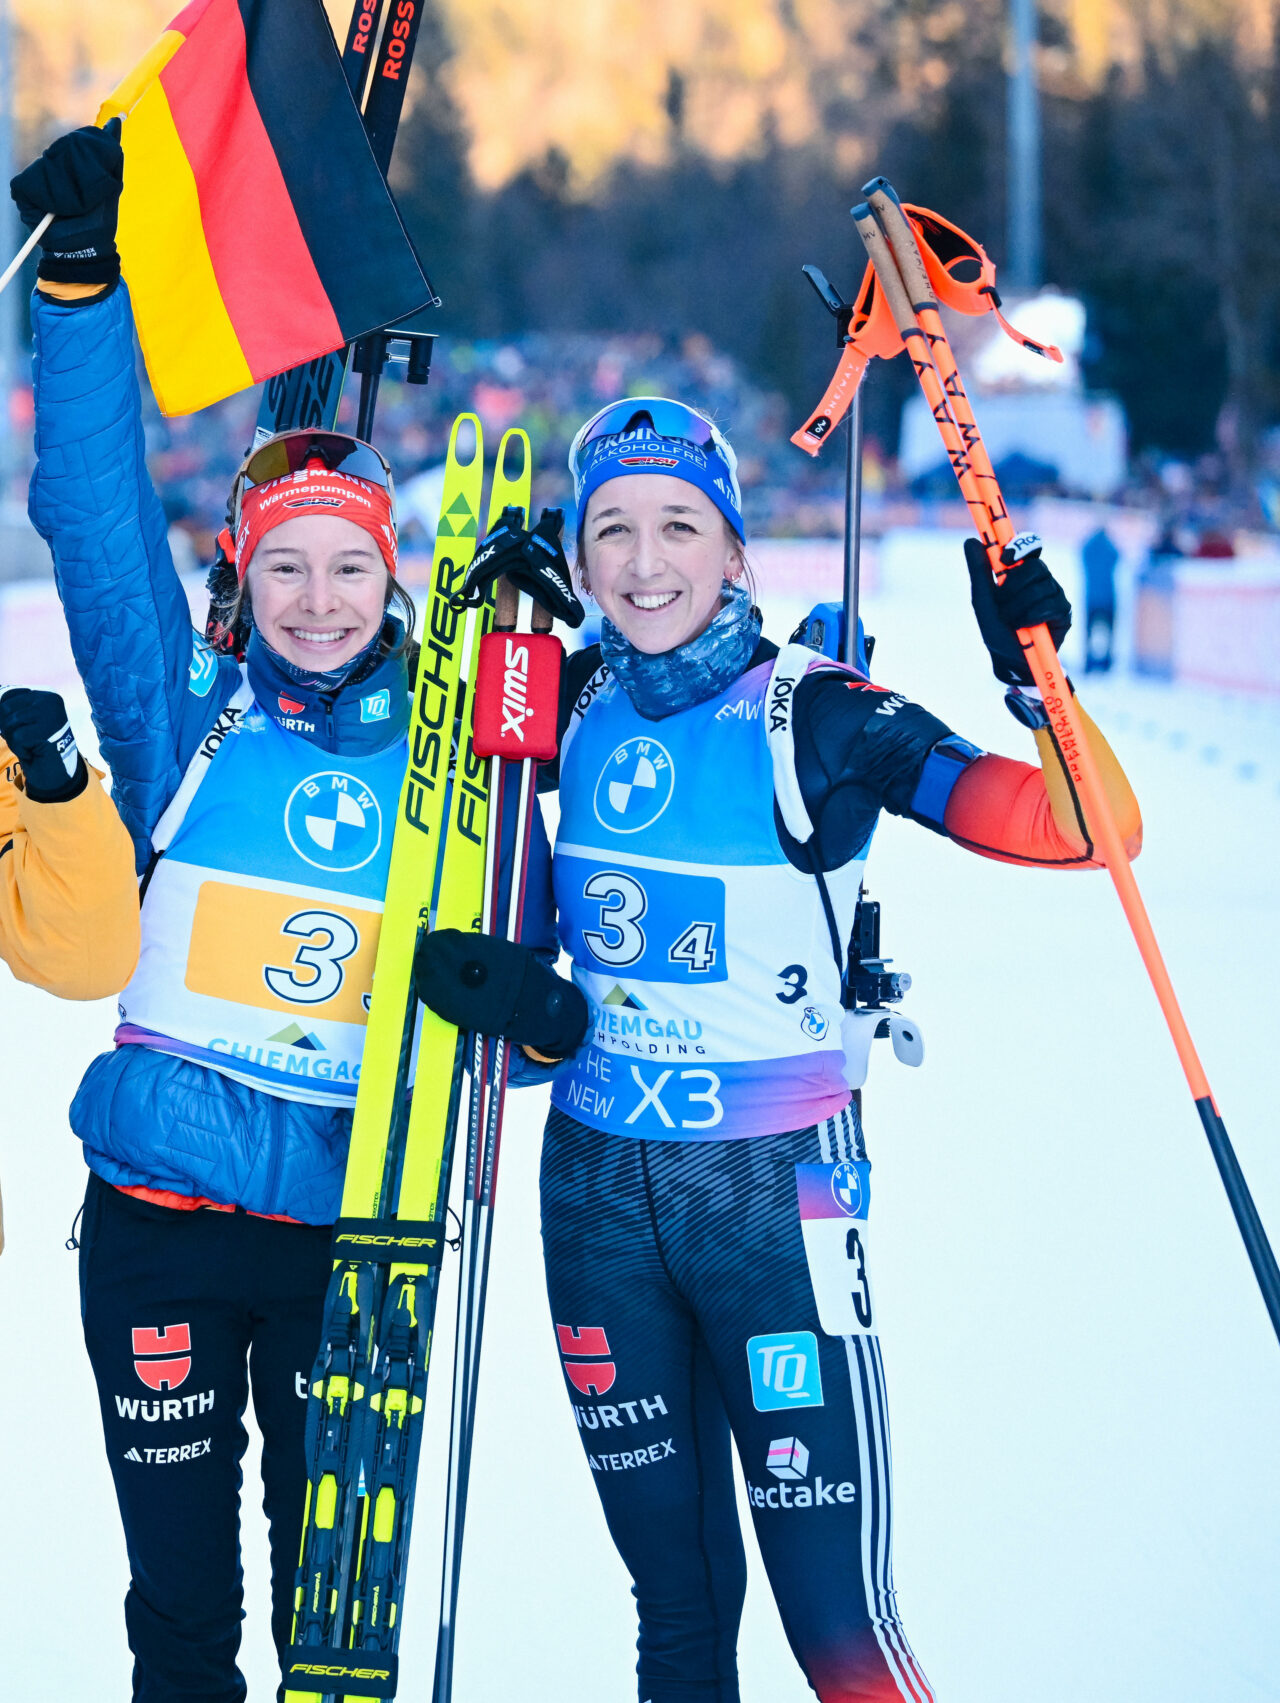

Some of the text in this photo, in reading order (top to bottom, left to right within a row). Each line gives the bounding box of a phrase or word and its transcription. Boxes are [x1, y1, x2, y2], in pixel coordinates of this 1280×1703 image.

[590, 443, 708, 470] ALKOHOLFREI
[258, 485, 372, 511] Wärmepumpen
[404, 556, 466, 836] FISCHER
[615, 741, 668, 771] BMW
[302, 776, 374, 810] BMW
[581, 869, 717, 974] 3 4
[263, 908, 360, 1005] 3
[775, 964, 809, 1005] 3
[566, 1079, 616, 1119] NEW
[624, 1064, 725, 1129] X3
[335, 1233, 438, 1248] FISCHER
[845, 1227, 872, 1329] 3
[756, 1342, 812, 1399] TQ
[114, 1388, 216, 1423] WÜRTH
[142, 1437, 213, 1465] TERREX
[599, 1438, 677, 1471] TERREX
[747, 1477, 856, 1510] tectake
[289, 1663, 391, 1680] FISCHER
